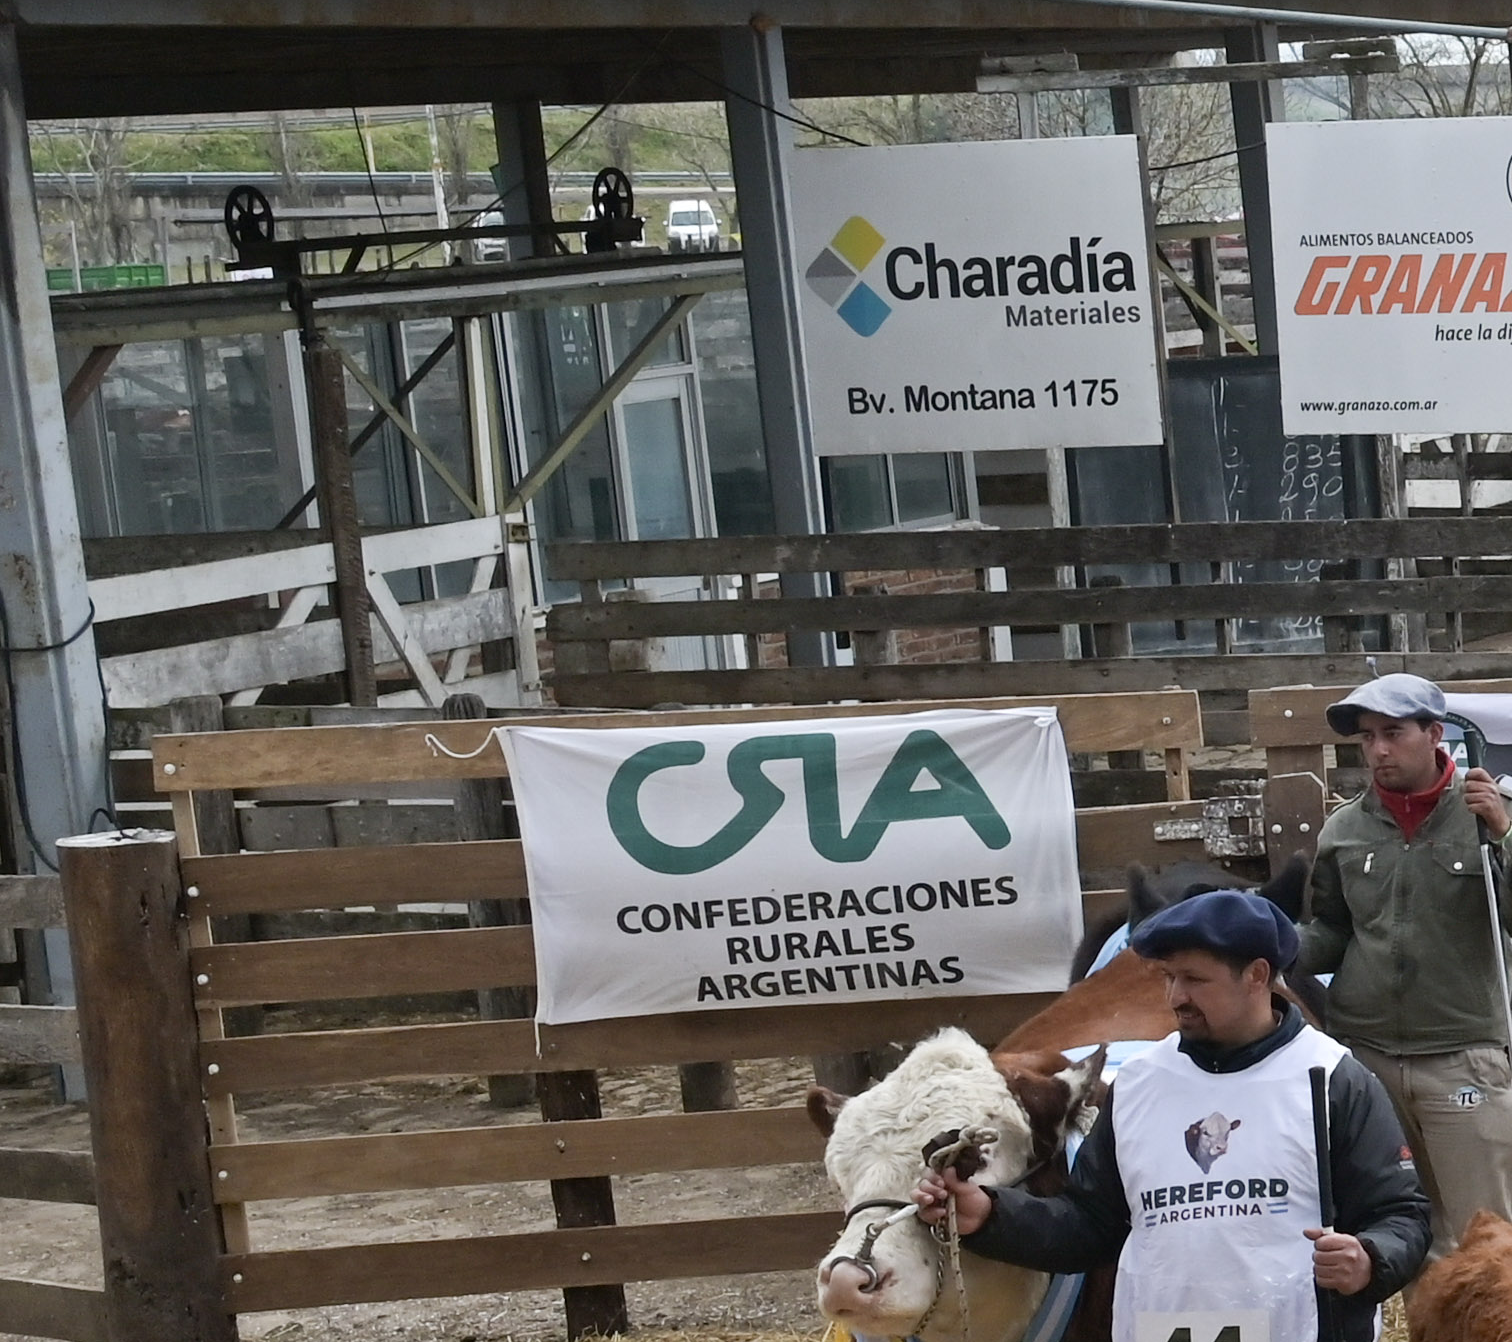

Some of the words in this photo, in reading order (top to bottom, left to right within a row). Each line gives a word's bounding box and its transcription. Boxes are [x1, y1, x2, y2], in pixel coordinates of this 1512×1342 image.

[1300, 233, 1372, 249] ALIMENTOS
[1376, 230, 1474, 247] BALANCEADOS
[885, 236, 1136, 302] Charadía
[1005, 300, 1141, 328] Materiales
[1435, 323, 1472, 342] hace
[1477, 323, 1492, 341] la
[848, 388, 894, 416] Bv.
[904, 383, 1035, 412] Montana
[1043, 380, 1119, 408] 1175
[1300, 399, 1438, 415] www.granazo.com.ar
[616, 876, 1019, 935] CONFEDERACIONES
[726, 923, 916, 965] RURALES
[697, 955, 965, 1002] ARGENTINAS
[1141, 1178, 1289, 1211] HEREFORD
[1159, 1203, 1262, 1225] ARGENTINA
